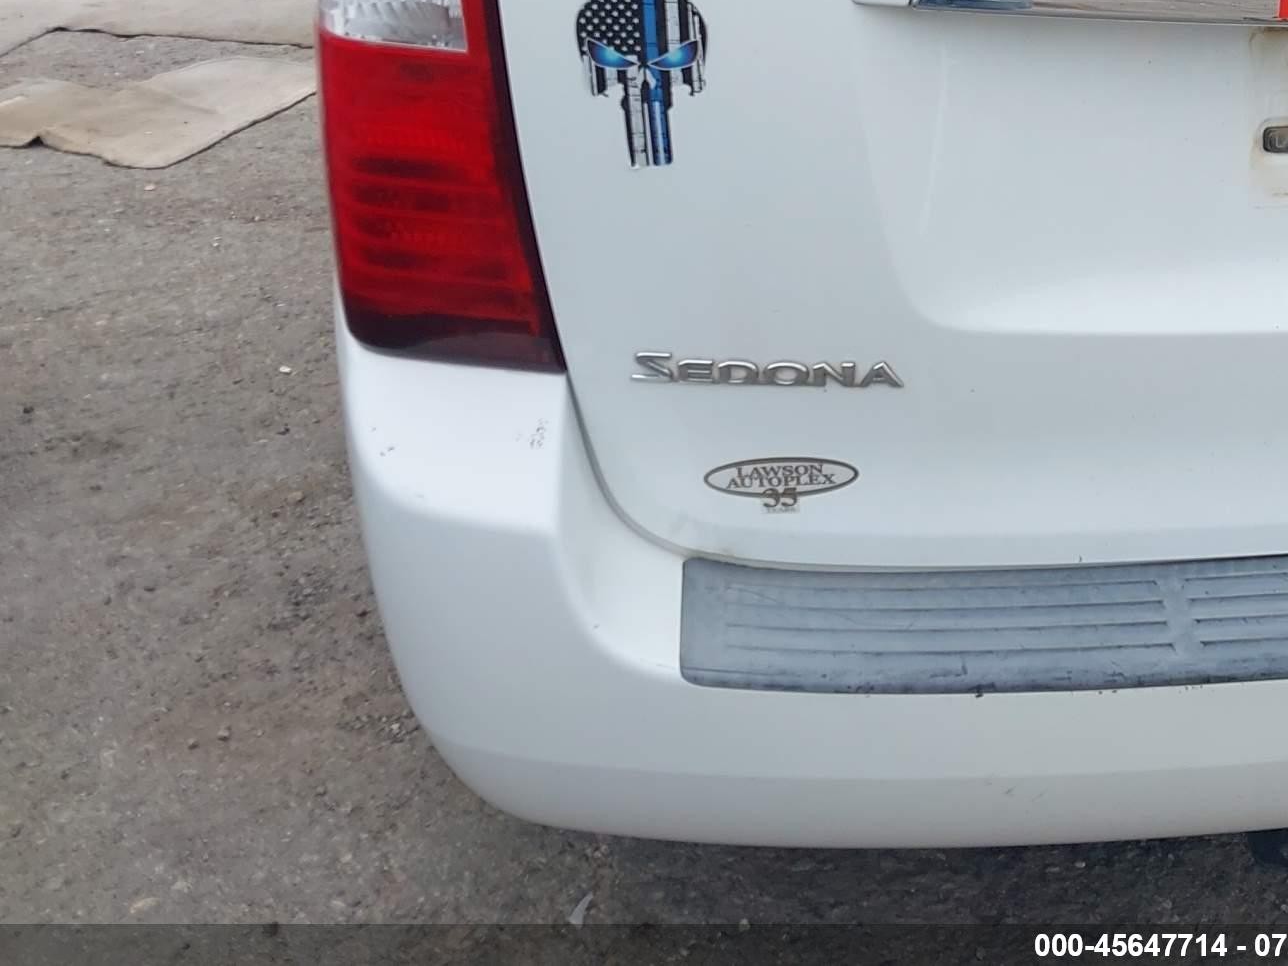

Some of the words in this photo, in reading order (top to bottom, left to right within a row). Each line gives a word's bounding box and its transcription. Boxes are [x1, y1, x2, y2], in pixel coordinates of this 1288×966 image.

[631, 351, 905, 388] SEDONA
[736, 464, 824, 479] LAWSON
[726, 473, 836, 490] AUTOPLEX
[762, 487, 798, 508] 35
